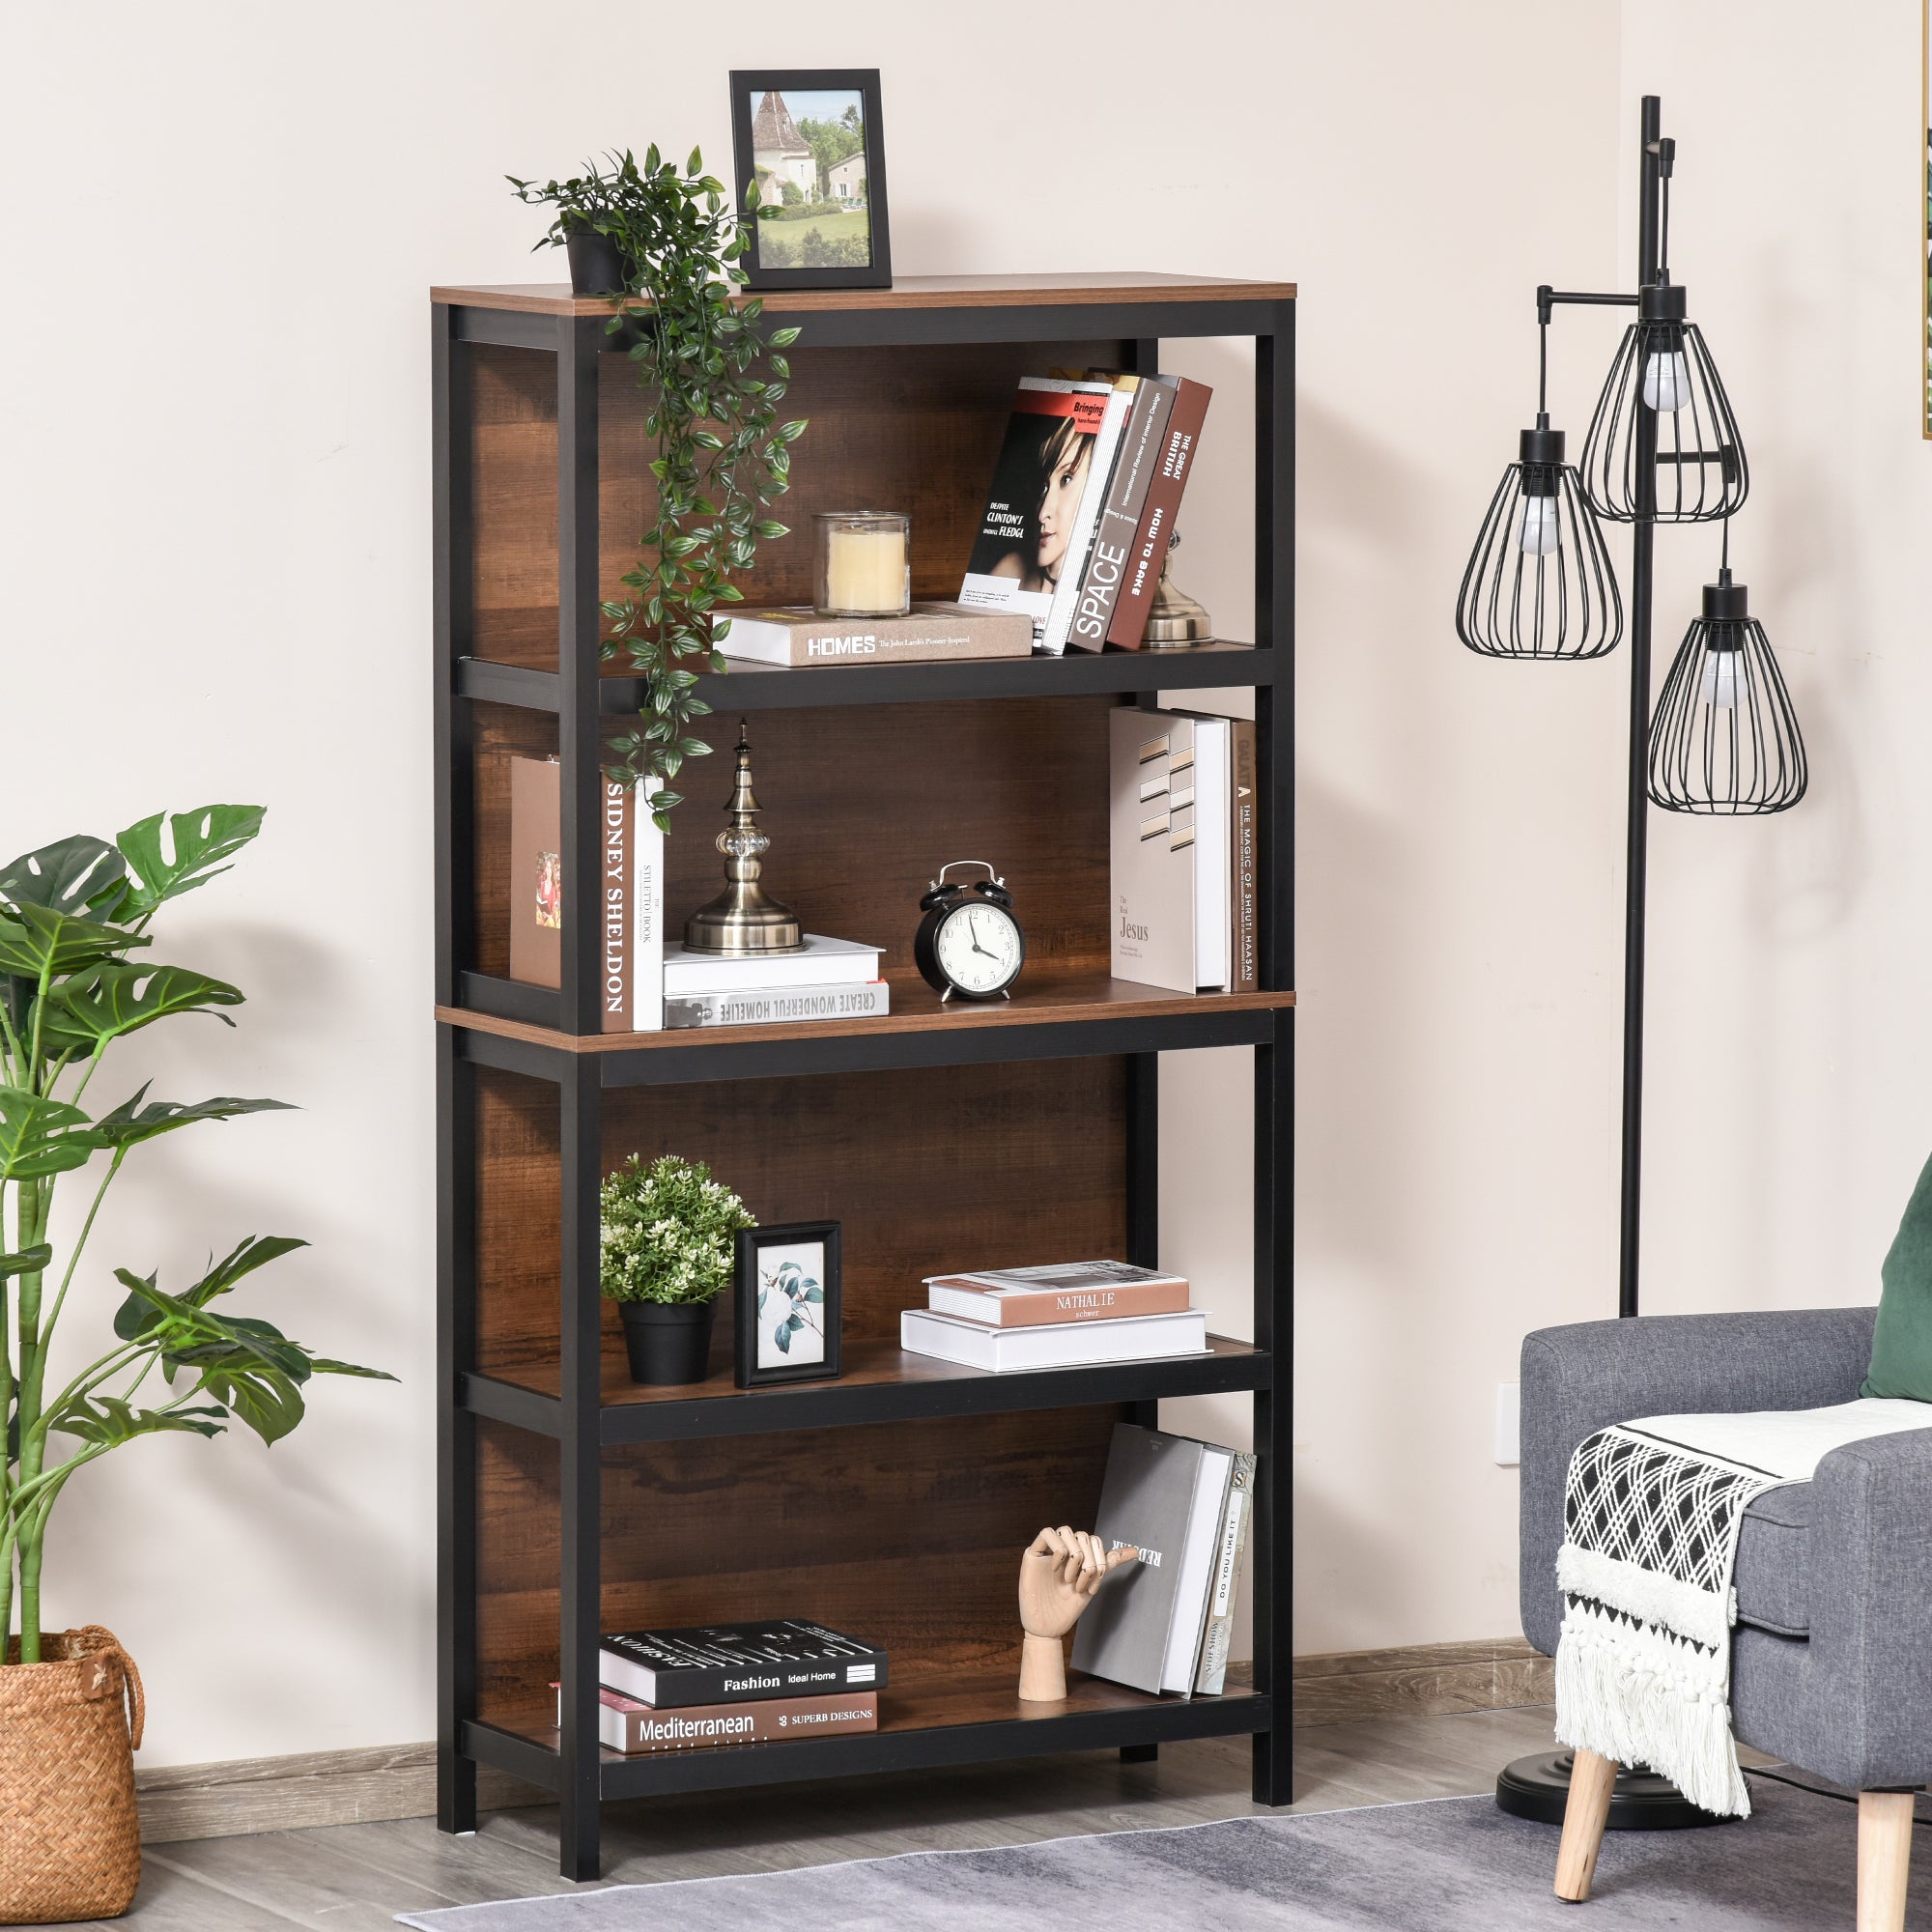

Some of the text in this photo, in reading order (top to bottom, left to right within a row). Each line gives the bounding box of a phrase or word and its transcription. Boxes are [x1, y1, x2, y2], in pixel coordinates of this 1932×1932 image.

[1073, 401, 1104, 416] Bringing
[1122, 393, 1160, 506] International Review of Interior Design
[1163, 431, 1182, 477] BRITISH
[1174, 435, 1191, 480] THE GREAT
[986, 512, 1024, 525] CLINTON'S
[1132, 508, 1163, 596] HOW TO BAKE
[1076, 541, 1124, 638] SPACE
[808, 636, 875, 656] HOMES
[891, 639, 903, 648] John
[1244, 872, 1252, 888] OF
[607, 783, 623, 1013] SIDNEY SHELDON
[998, 925, 1004, 935] 2
[1120, 916, 1149, 942] Jesus
[1005, 942, 1010, 951] 3
[958, 971, 965, 980] 7
[974, 976, 980, 985] 6
[990, 971, 996, 980] 5
[720, 992, 876, 1021] CREATE WONDERFUL HOMELIFE
[1056, 1293, 1115, 1309] NATHALIE
[1220, 1583, 1227, 1599] DO
[1230, 1520, 1236, 1529] IT
[724, 1672, 837, 1691] Fashion Ideal Home
[779, 1709, 872, 1727] 65 SUPERB DESIGNS
[639, 1716, 754, 1742] Mediterranean
